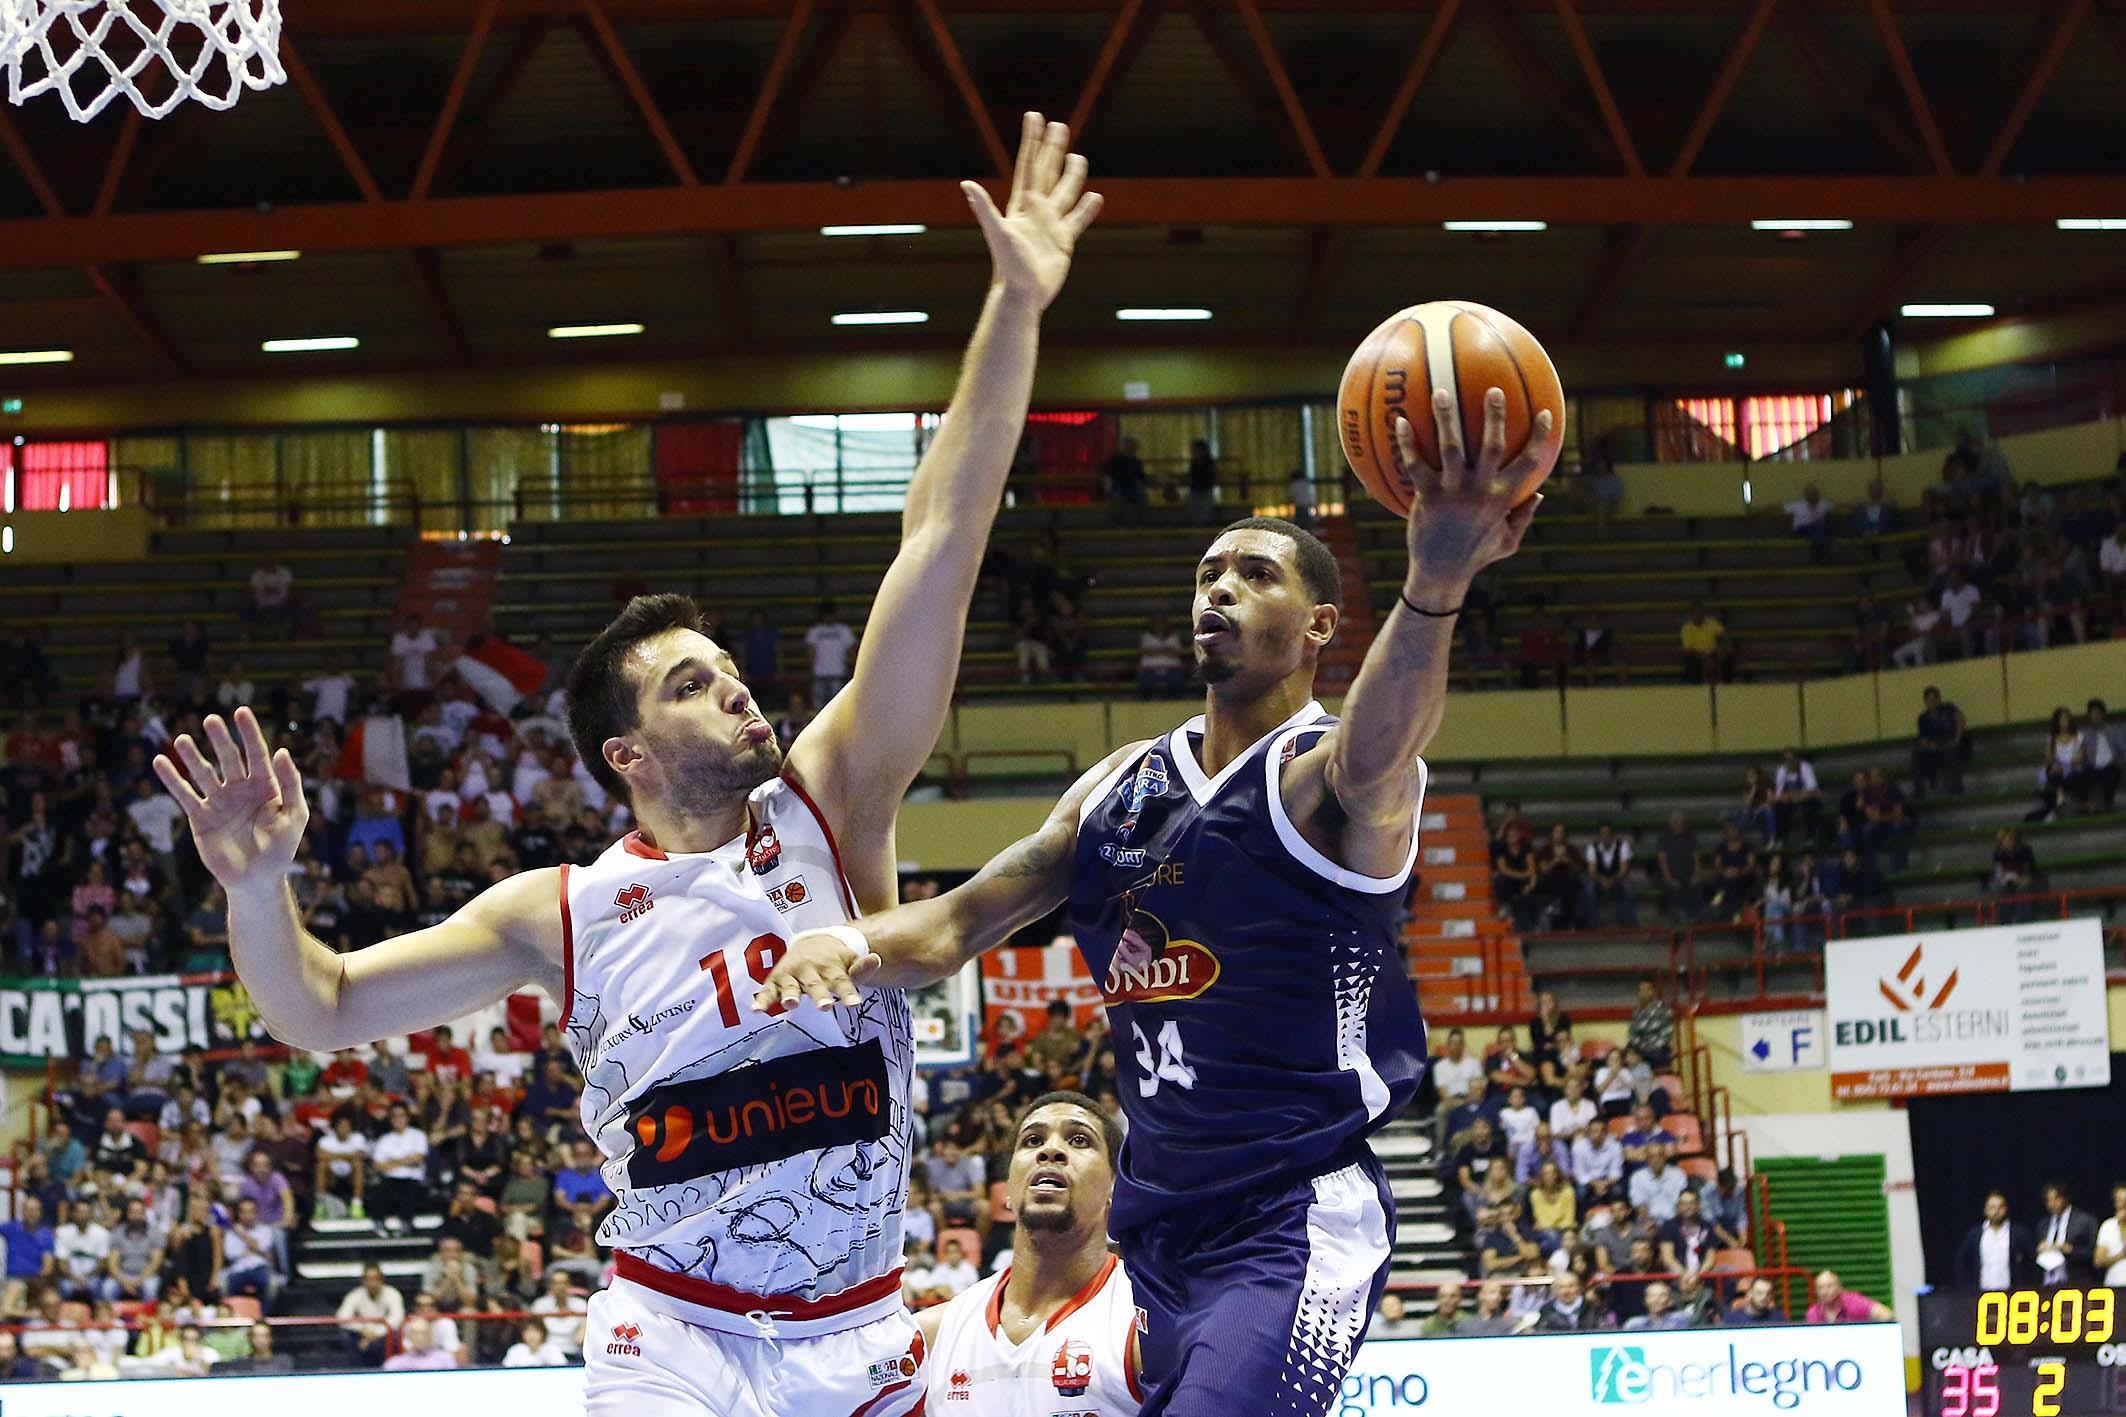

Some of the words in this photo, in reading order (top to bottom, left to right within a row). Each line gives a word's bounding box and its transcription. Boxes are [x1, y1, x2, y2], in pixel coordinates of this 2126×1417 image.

[1346, 409, 1364, 458] FIBA
[699, 932, 788, 1029] 19
[601, 1028, 634, 1054] UXURY
[651, 1001, 693, 1027] LIVING
[1792, 1028, 1812, 1063] F
[1836, 1018, 1907, 1047] EDIL
[1914, 1009, 2009, 1043] ESTERNI
[1131, 1020, 1199, 1098] 34
[1975, 1287, 2115, 1346] 08:03
[1614, 1343, 1860, 1409] enerlegno
[1932, 1346, 1994, 1371] CASA
[1942, 1364, 1999, 1417] 35
[2032, 1363, 2066, 1417] 2
